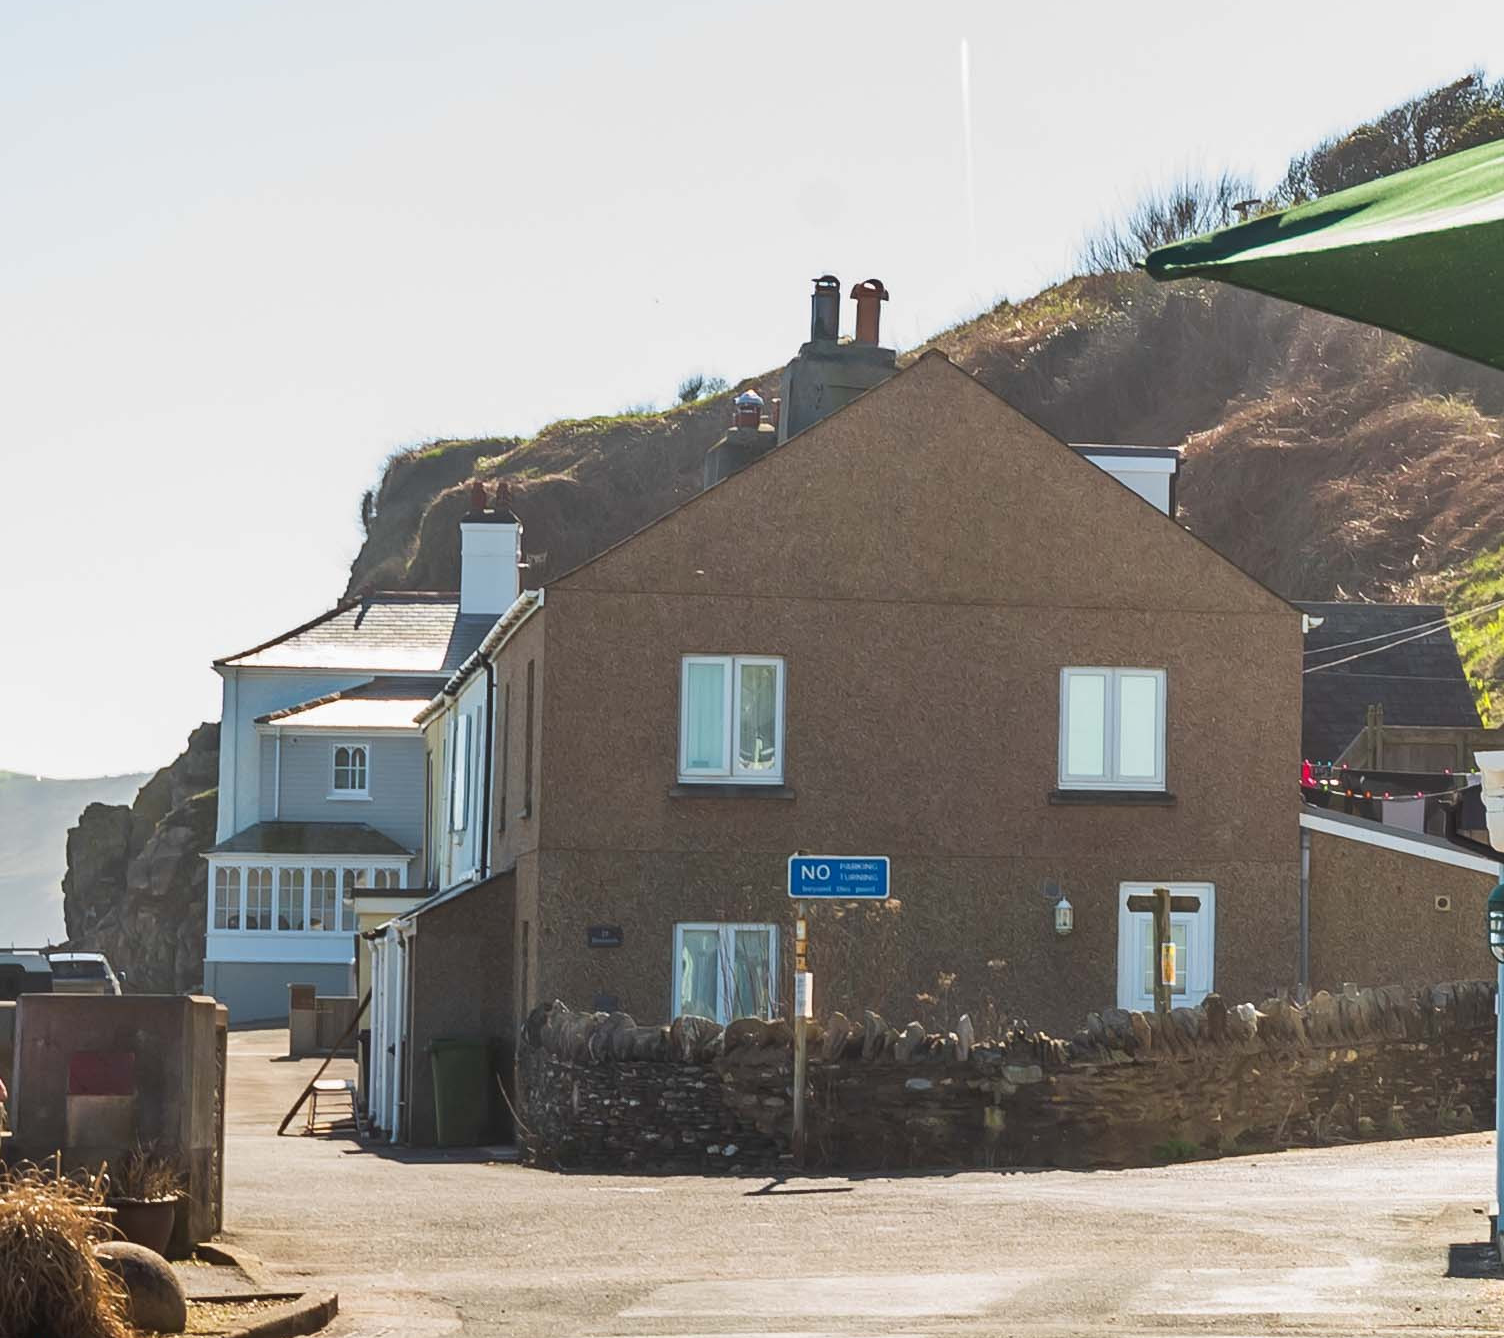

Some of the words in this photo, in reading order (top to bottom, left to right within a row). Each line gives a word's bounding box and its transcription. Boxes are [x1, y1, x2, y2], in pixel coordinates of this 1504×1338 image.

[840, 862, 878, 870] PARKING
[801, 864, 831, 880] NO
[840, 873, 879, 881] TURNING
[802, 885, 831, 893] beyond
